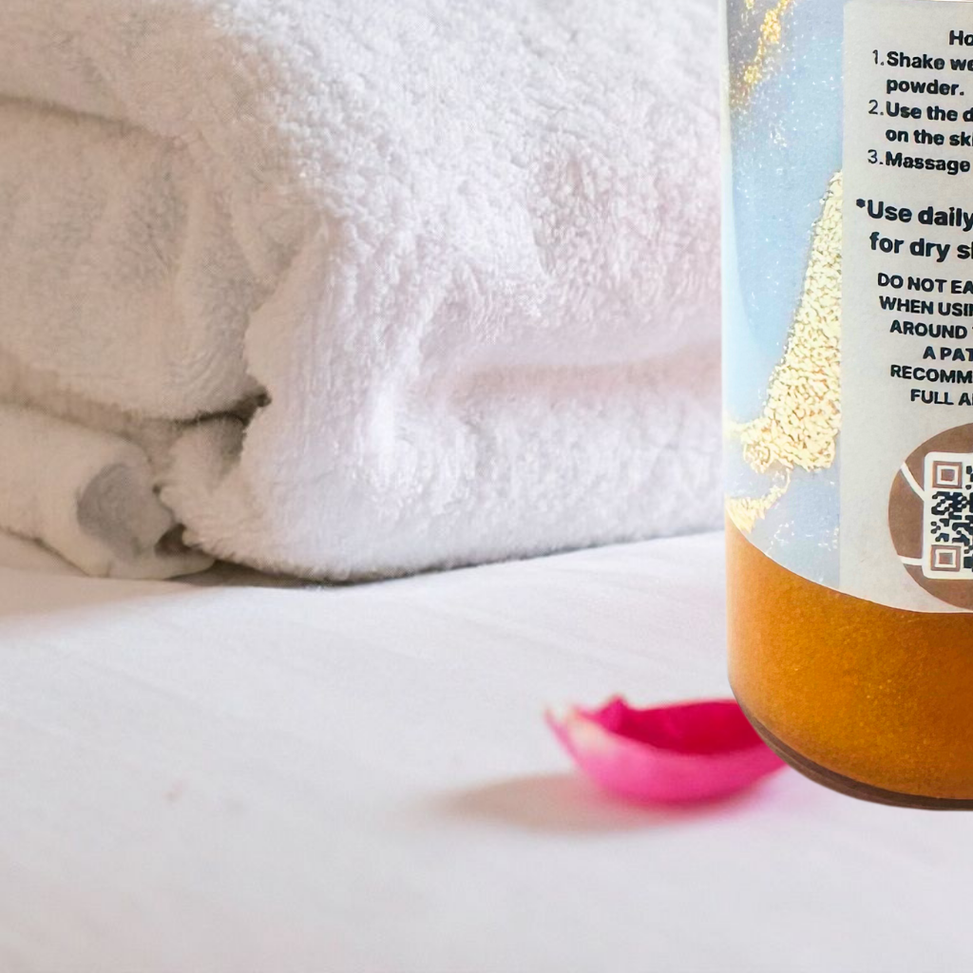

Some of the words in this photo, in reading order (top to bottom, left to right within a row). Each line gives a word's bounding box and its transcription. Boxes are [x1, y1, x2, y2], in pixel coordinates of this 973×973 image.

[886, 79, 964, 96] powder.
[926, 106, 958, 121] the
[886, 129, 908, 143] on
[914, 129, 944, 145] the
[869, 232, 904, 253] for
[910, 238, 950, 262] dry
[877, 273, 903, 289] DO
[908, 276, 946, 293] NOT
[879, 295, 934, 315] WHEN
[890, 319, 967, 339] AROUND
[922, 346, 936, 360] A
[910, 389, 954, 405] FULL
